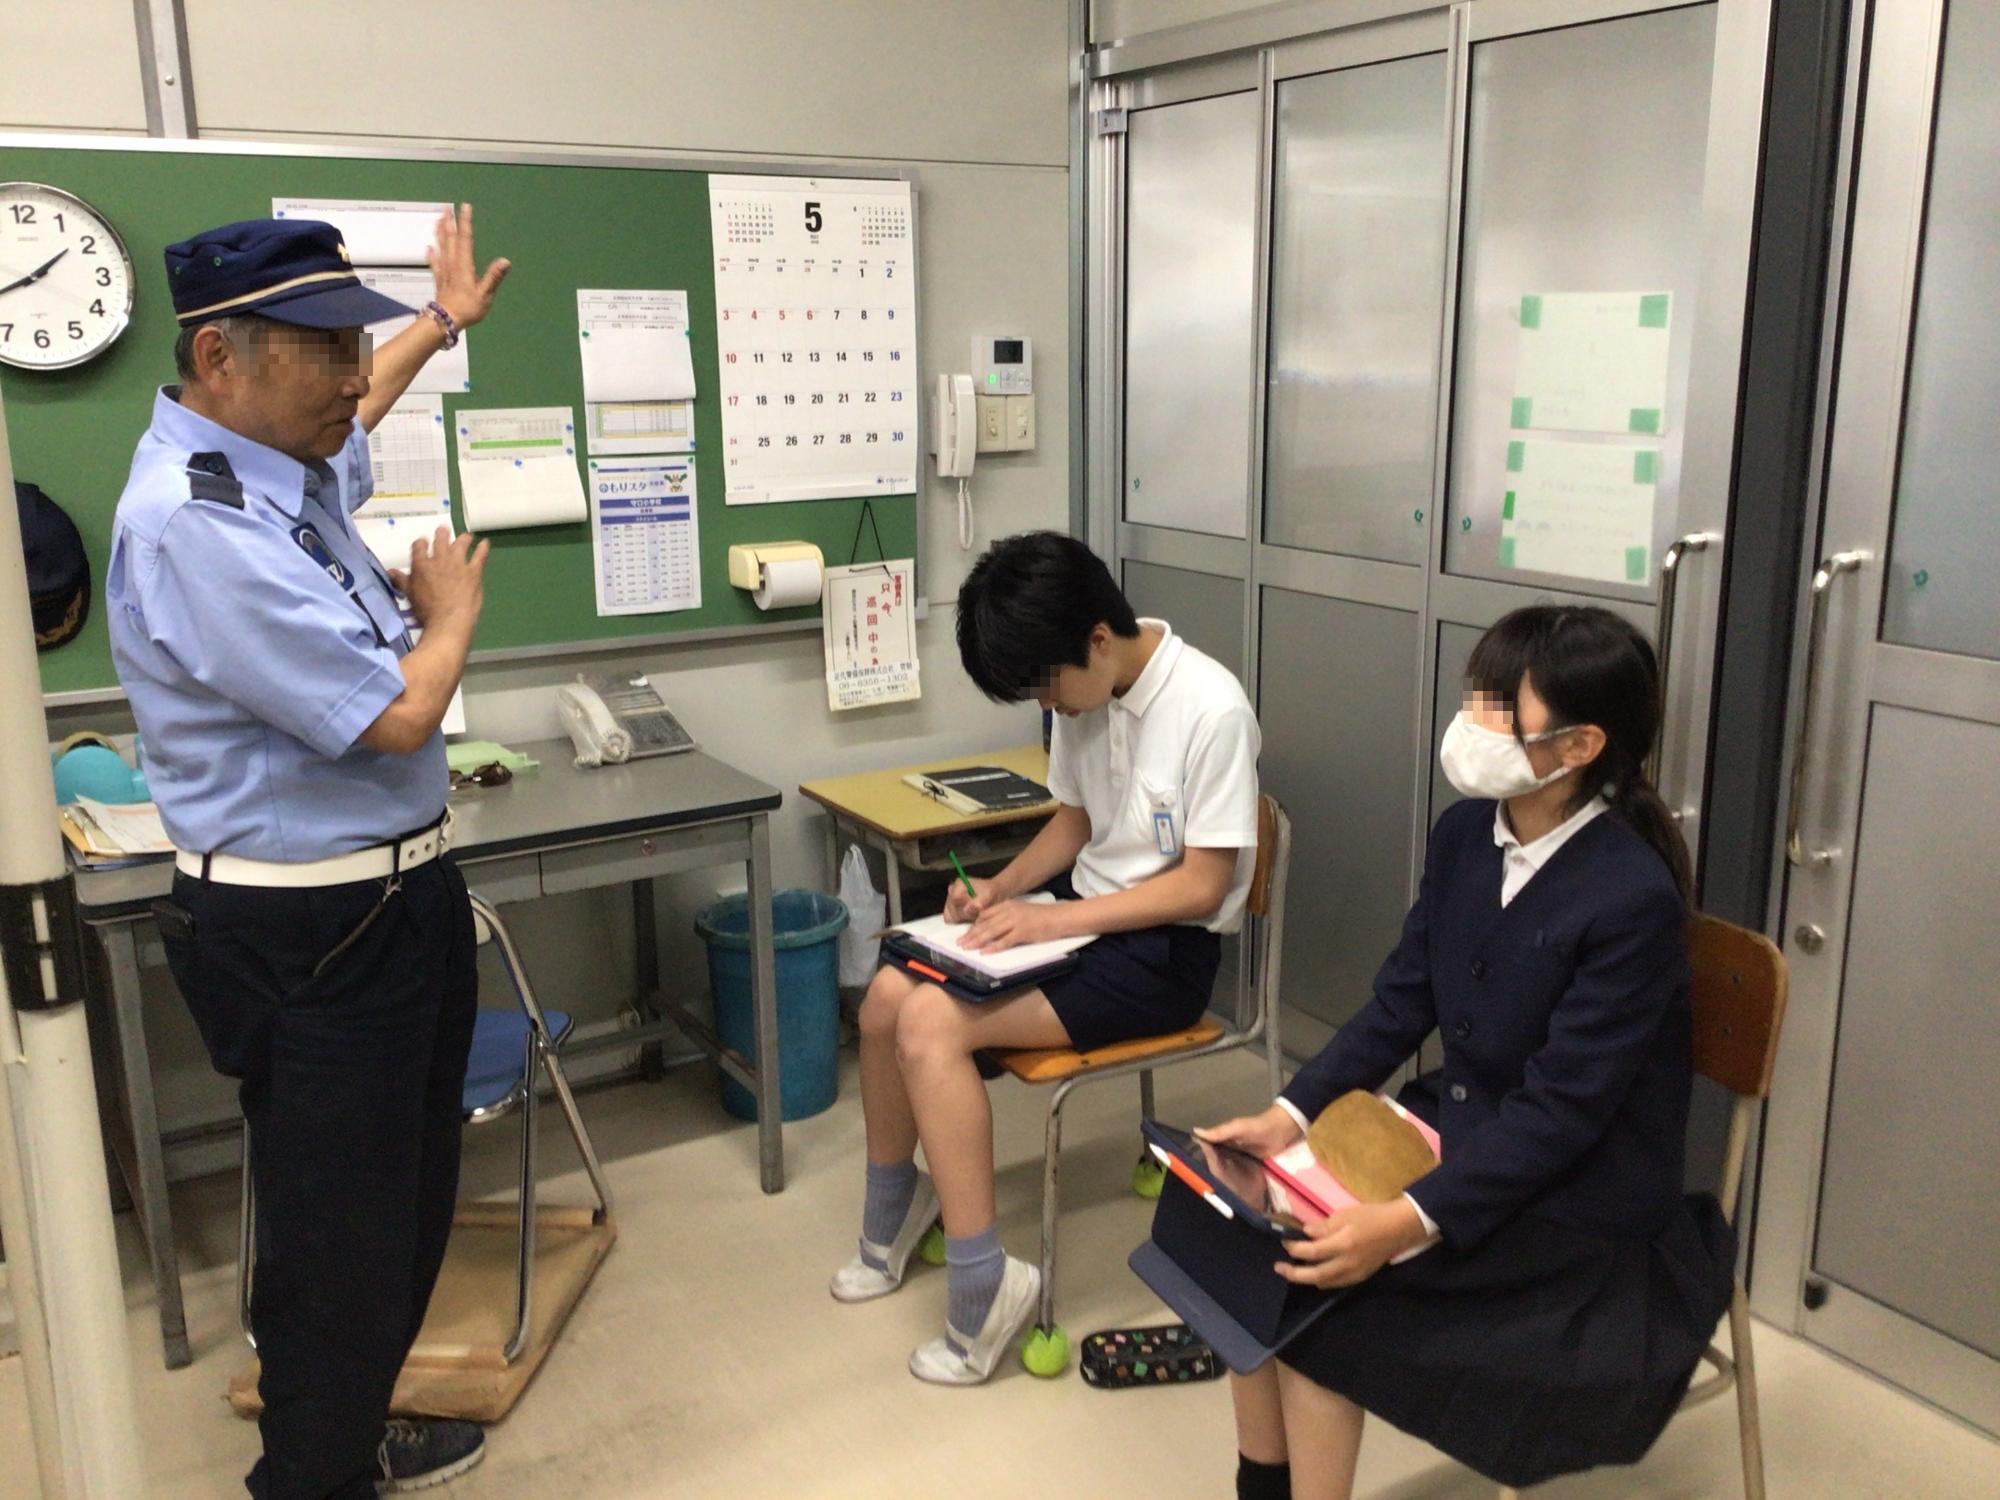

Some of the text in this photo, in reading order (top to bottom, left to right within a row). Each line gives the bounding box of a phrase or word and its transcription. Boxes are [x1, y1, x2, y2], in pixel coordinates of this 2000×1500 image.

[8, 204, 37, 224] 12
[53, 214, 65, 232] 1
[805, 202, 822, 233] 5
[80, 236, 96, 254] 2
[96, 267, 112, 286] 3
[859, 268, 864, 277] 1
[886, 268, 893, 278] 2
[89, 299, 106, 317] 4
[723, 310, 894, 320] 3 4 5 6 7 8 9
[0, 324, 15, 342] 7
[34, 330, 50, 348] 6
[68, 321, 83, 339] 5
[726, 352, 900, 364] 10 11 12 13 14 15 16
[728, 392, 902, 406] 17 18 19 20 21 22 23
[758, 438, 770, 447] 25
[786, 436, 798, 446] 26
[813, 436, 824, 445] 27
[840, 434, 851, 444] 28
[866, 433, 878, 443] 29
[892, 432, 904, 442] 30
[610, 482, 646, 493] もりスタ
